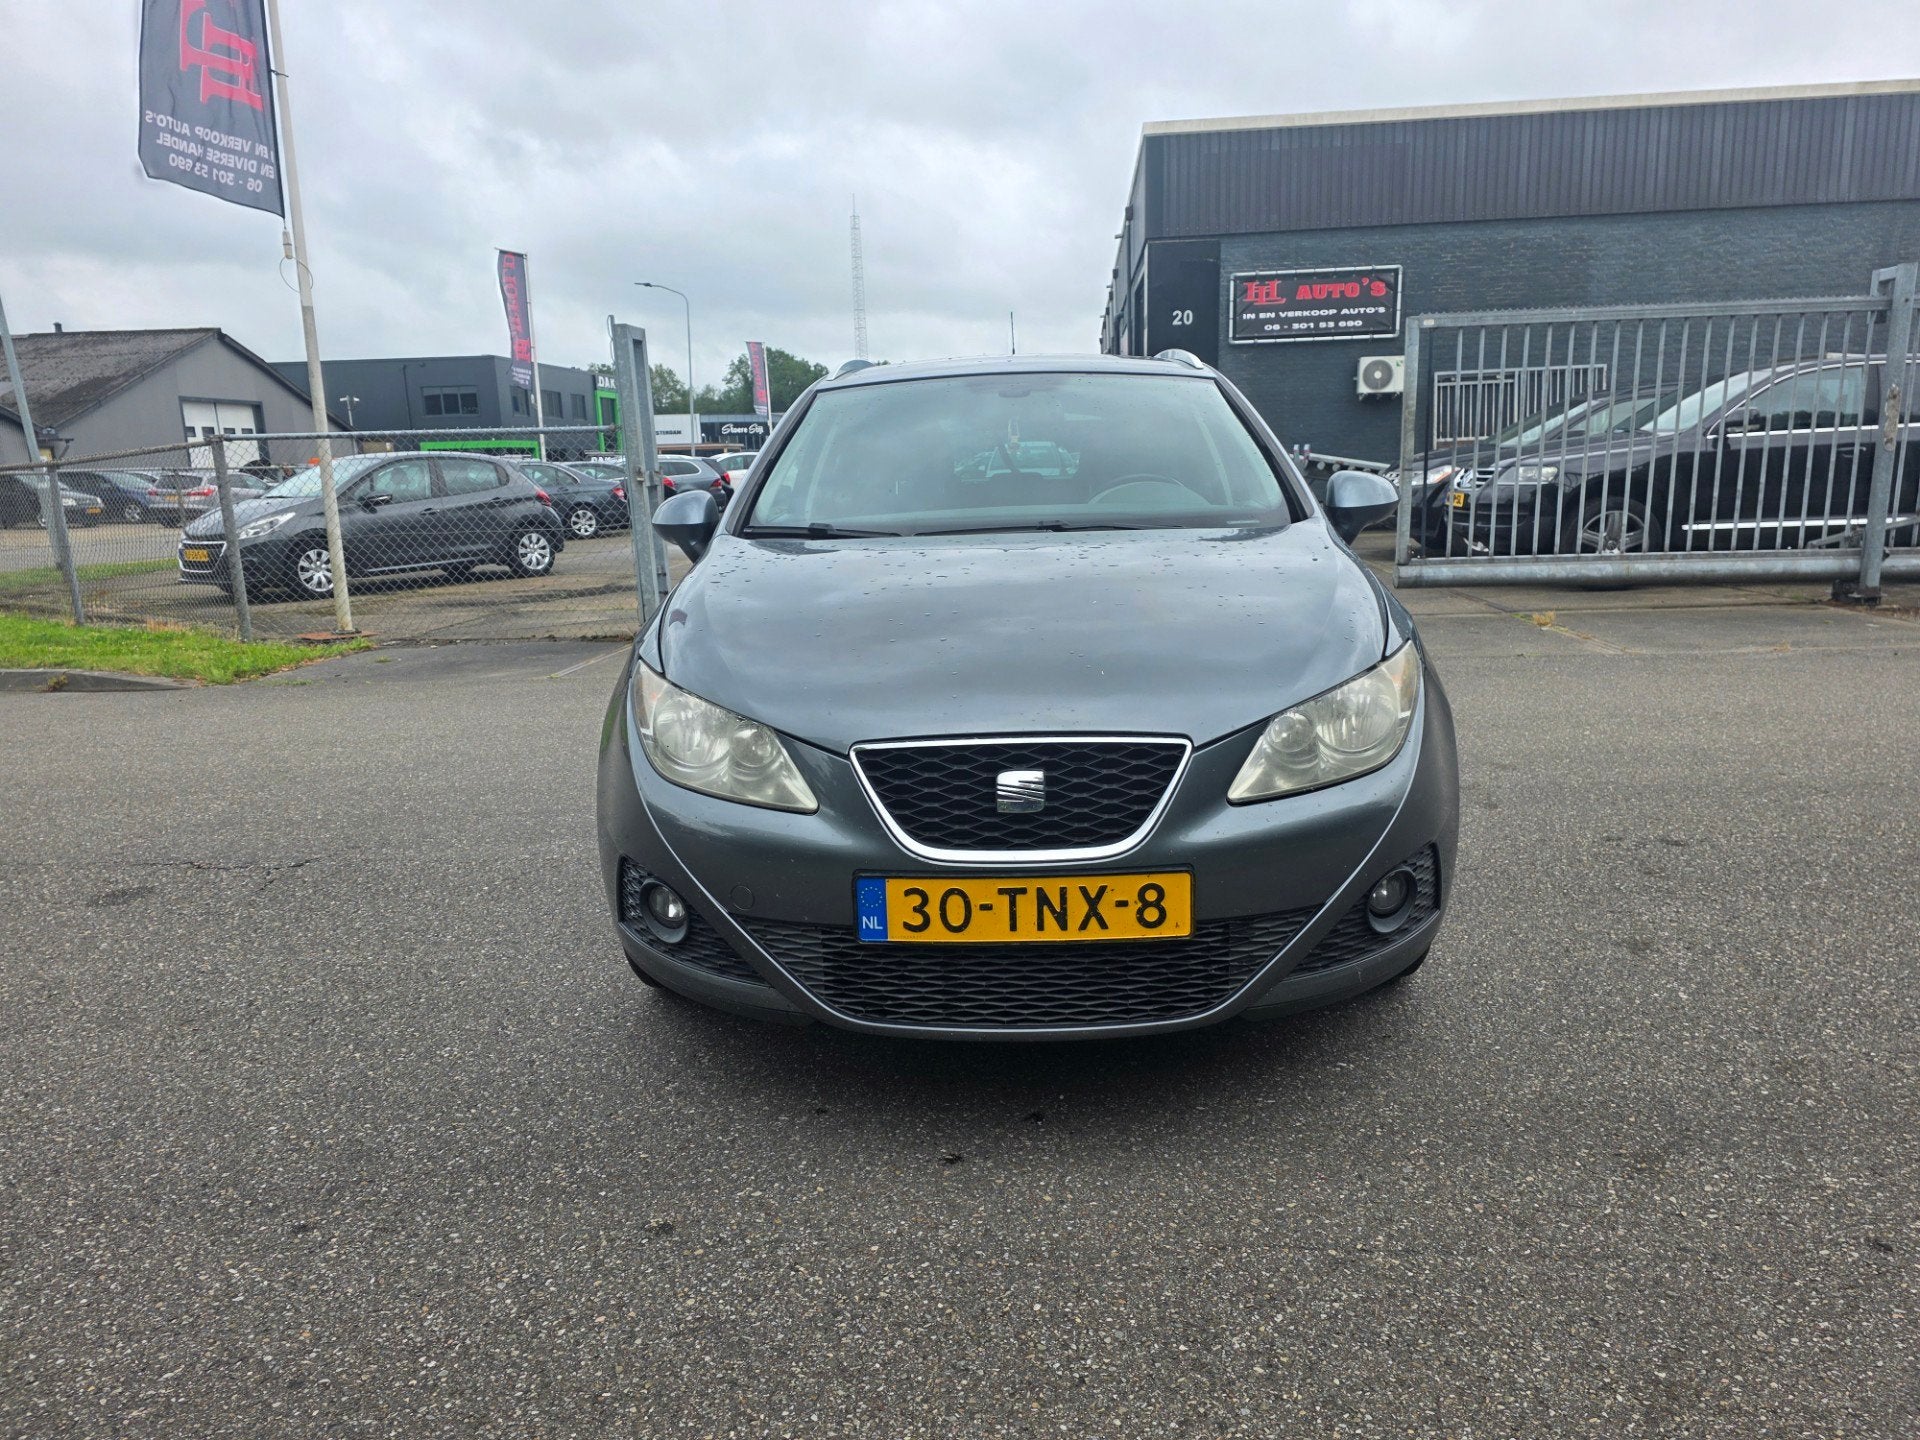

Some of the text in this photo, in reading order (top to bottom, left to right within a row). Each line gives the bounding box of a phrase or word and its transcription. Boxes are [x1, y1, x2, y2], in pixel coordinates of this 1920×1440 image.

[1295, 277, 1387, 300] AUTO'S
[1171, 309, 1194, 326] 20
[1278, 309, 1338, 318] VERKOOP
[1340, 306, 1386, 315] AUTO'S
[1292, 322, 1314, 330] 301
[902, 882, 1168, 934] 30-TNX-8
[862, 916, 883, 930] NL
